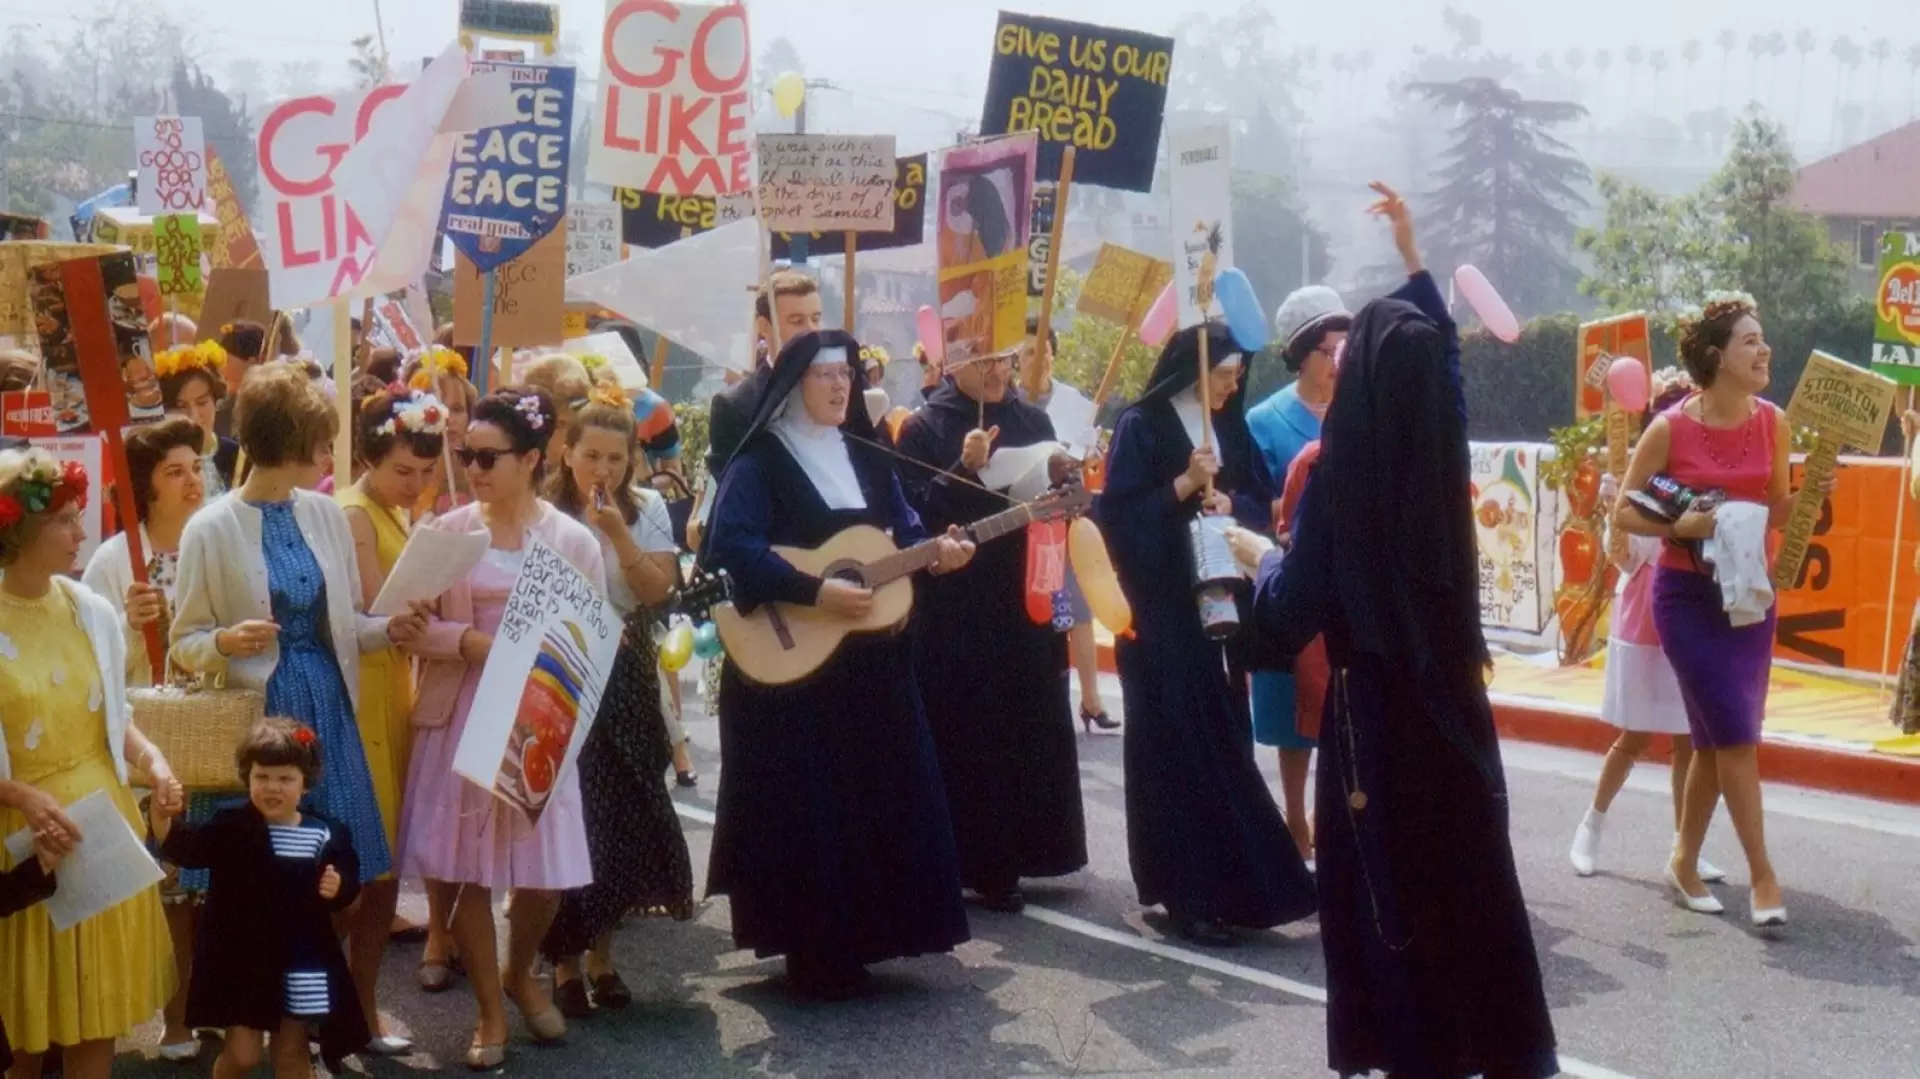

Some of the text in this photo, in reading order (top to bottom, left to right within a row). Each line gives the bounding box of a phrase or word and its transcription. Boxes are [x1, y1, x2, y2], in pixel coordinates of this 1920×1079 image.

[603, 0, 749, 93] GO
[1069, 35, 1108, 72] US
[604, 84, 748, 156] LIKE
[140, 150, 201, 171] GOOD
[158, 169, 194, 189] FOR
[645, 151, 752, 198] ME
[155, 187, 205, 210] YOU
[1802, 375, 1881, 424] STOCKTON
